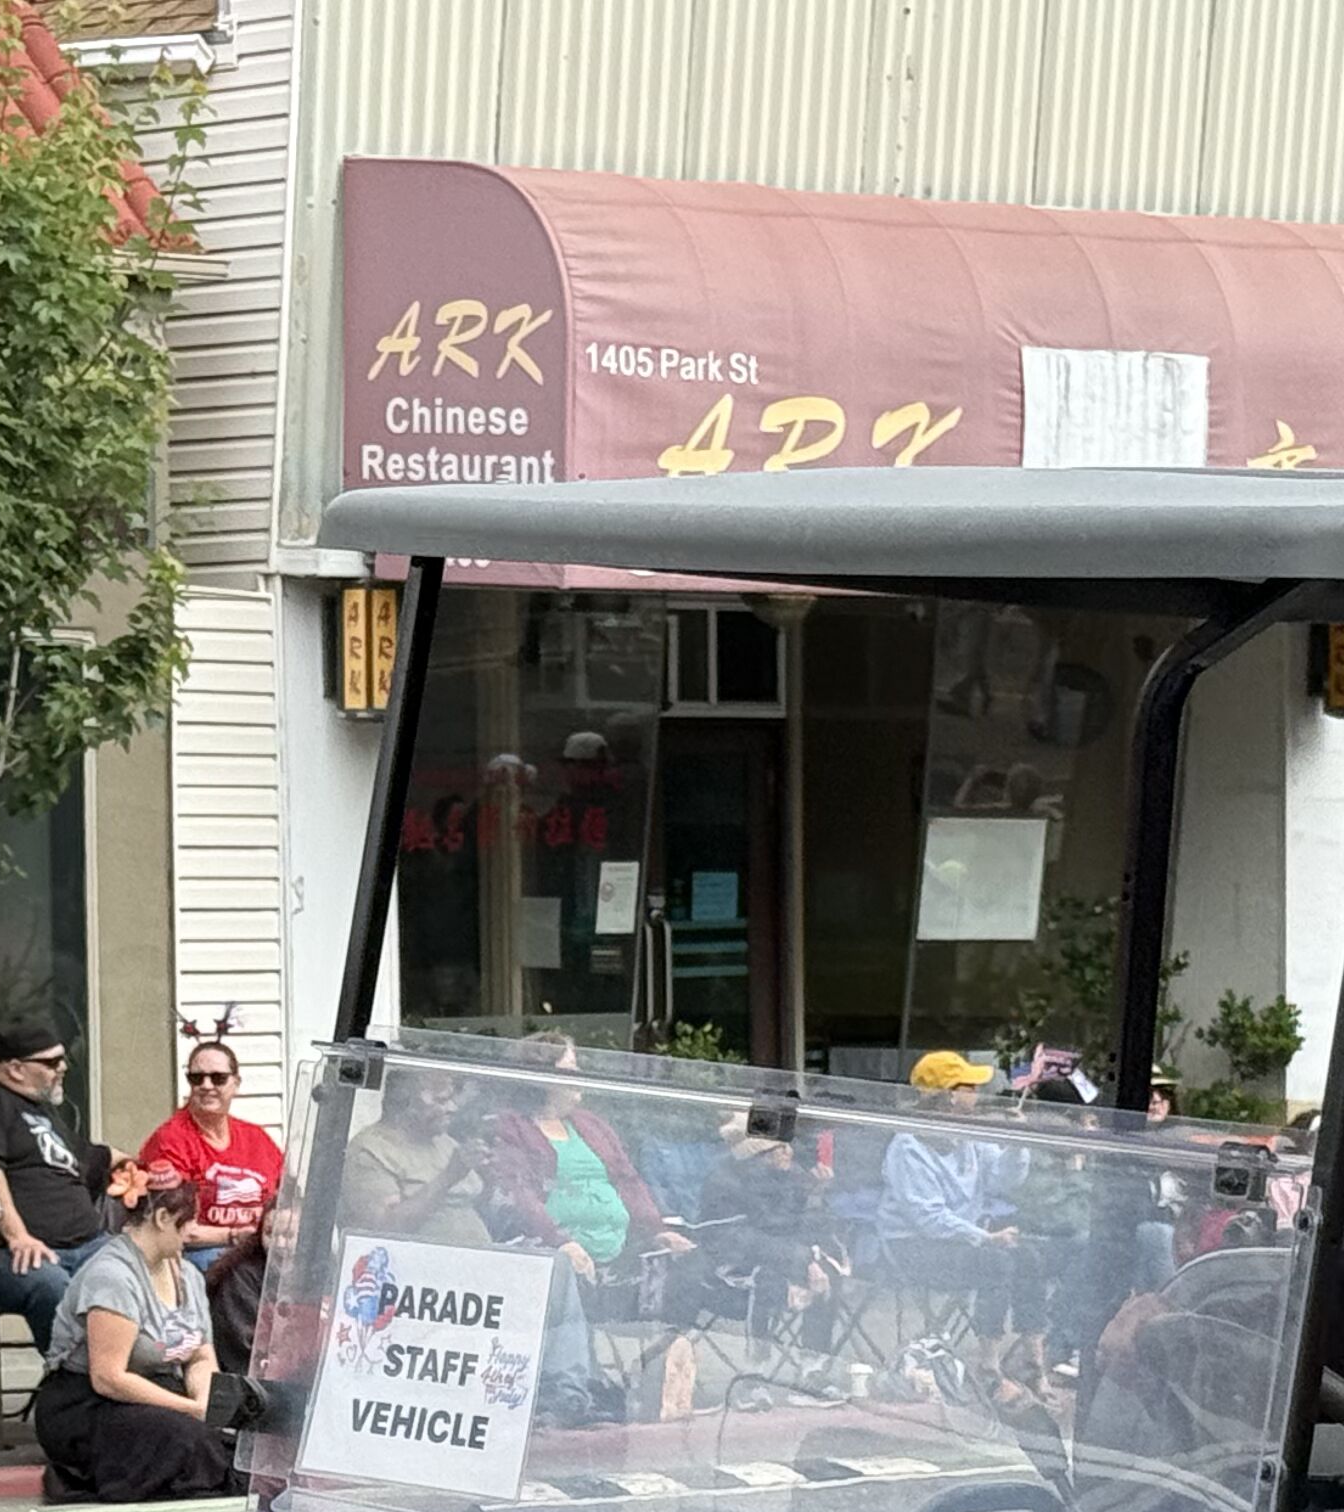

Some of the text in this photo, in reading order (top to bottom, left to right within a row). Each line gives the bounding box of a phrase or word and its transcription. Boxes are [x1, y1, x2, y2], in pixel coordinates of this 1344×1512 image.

[367, 299, 553, 386] ARK
[585, 341, 759, 385] 1405 Park St
[385, 396, 529, 436] Chinese
[361, 444, 555, 485] Restaurant
[378, 1282, 504, 1330] PARADE
[383, 1343, 479, 1386] STAFF
[352, 1398, 490, 1450] VEHICLE
